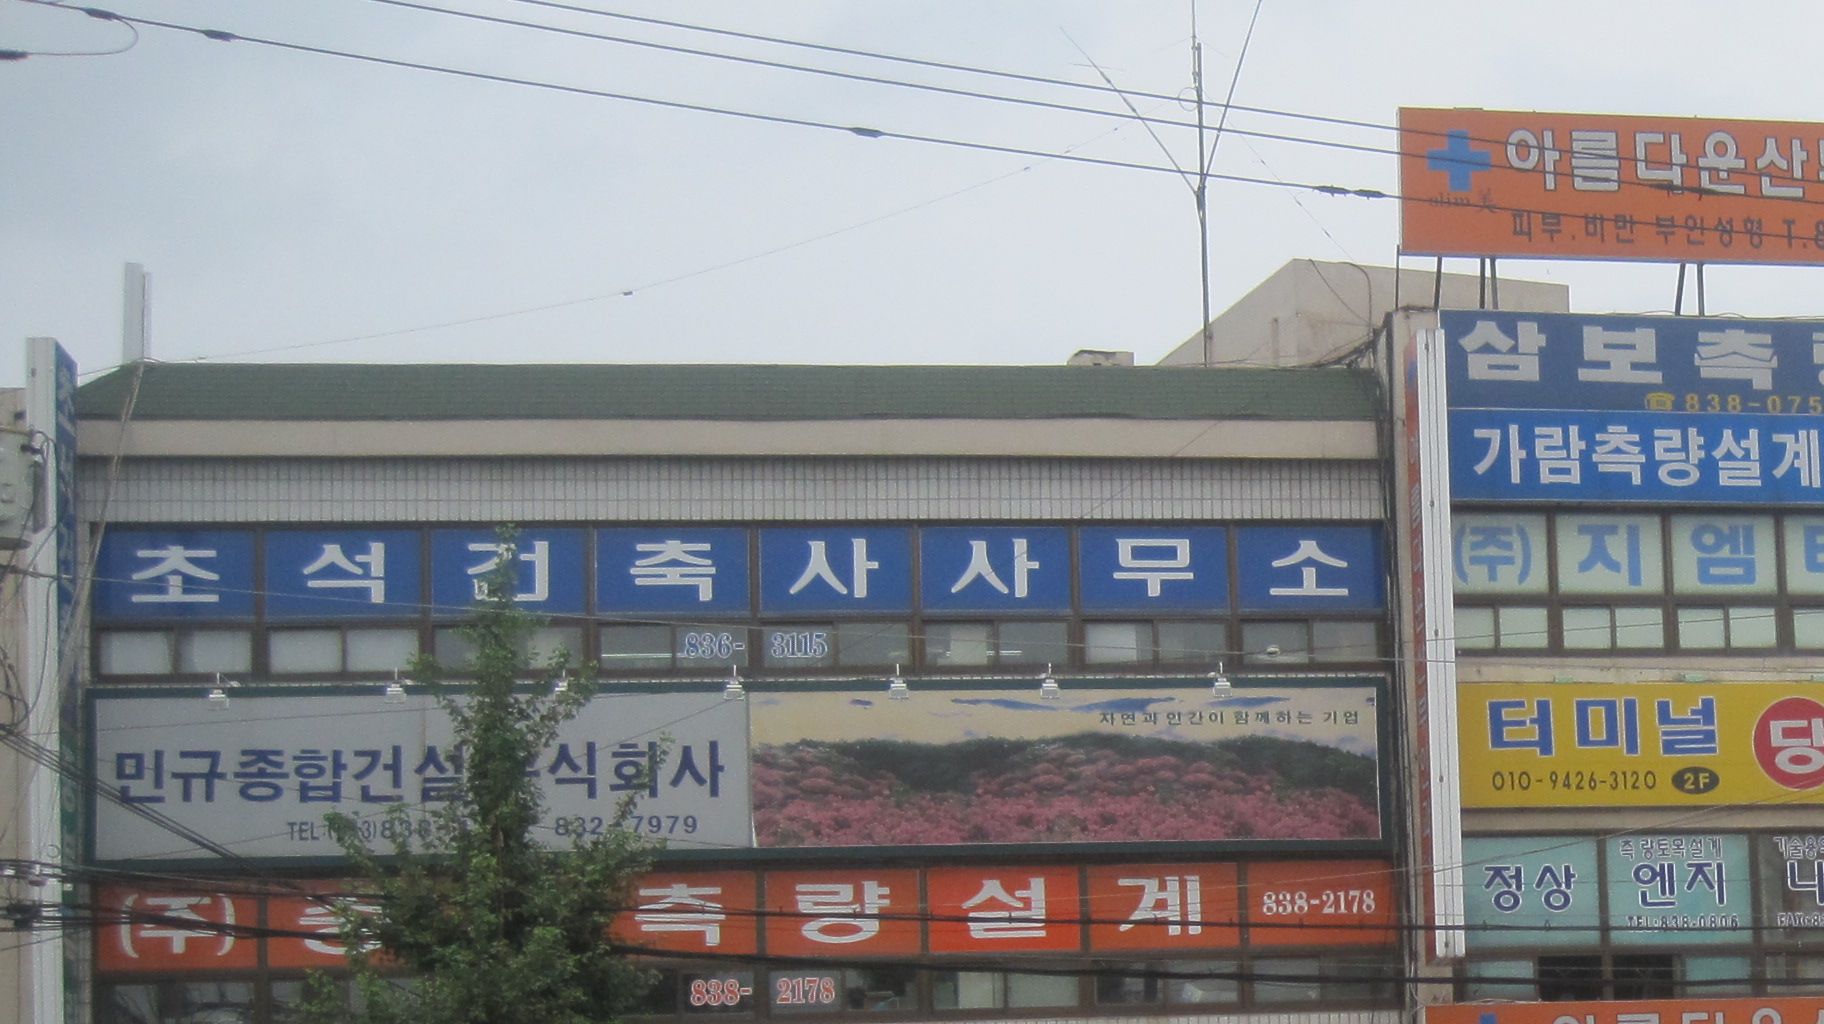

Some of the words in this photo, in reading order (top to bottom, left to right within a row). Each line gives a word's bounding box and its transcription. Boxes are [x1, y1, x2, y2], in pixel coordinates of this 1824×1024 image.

[1487, 693, 1721, 758] 터미널
[115, 740, 725, 804] 민규종합건설식회사
[1491, 768, 1659, 793] 010-9426-3120
[1261, 889, 1376, 918] 838-2178
